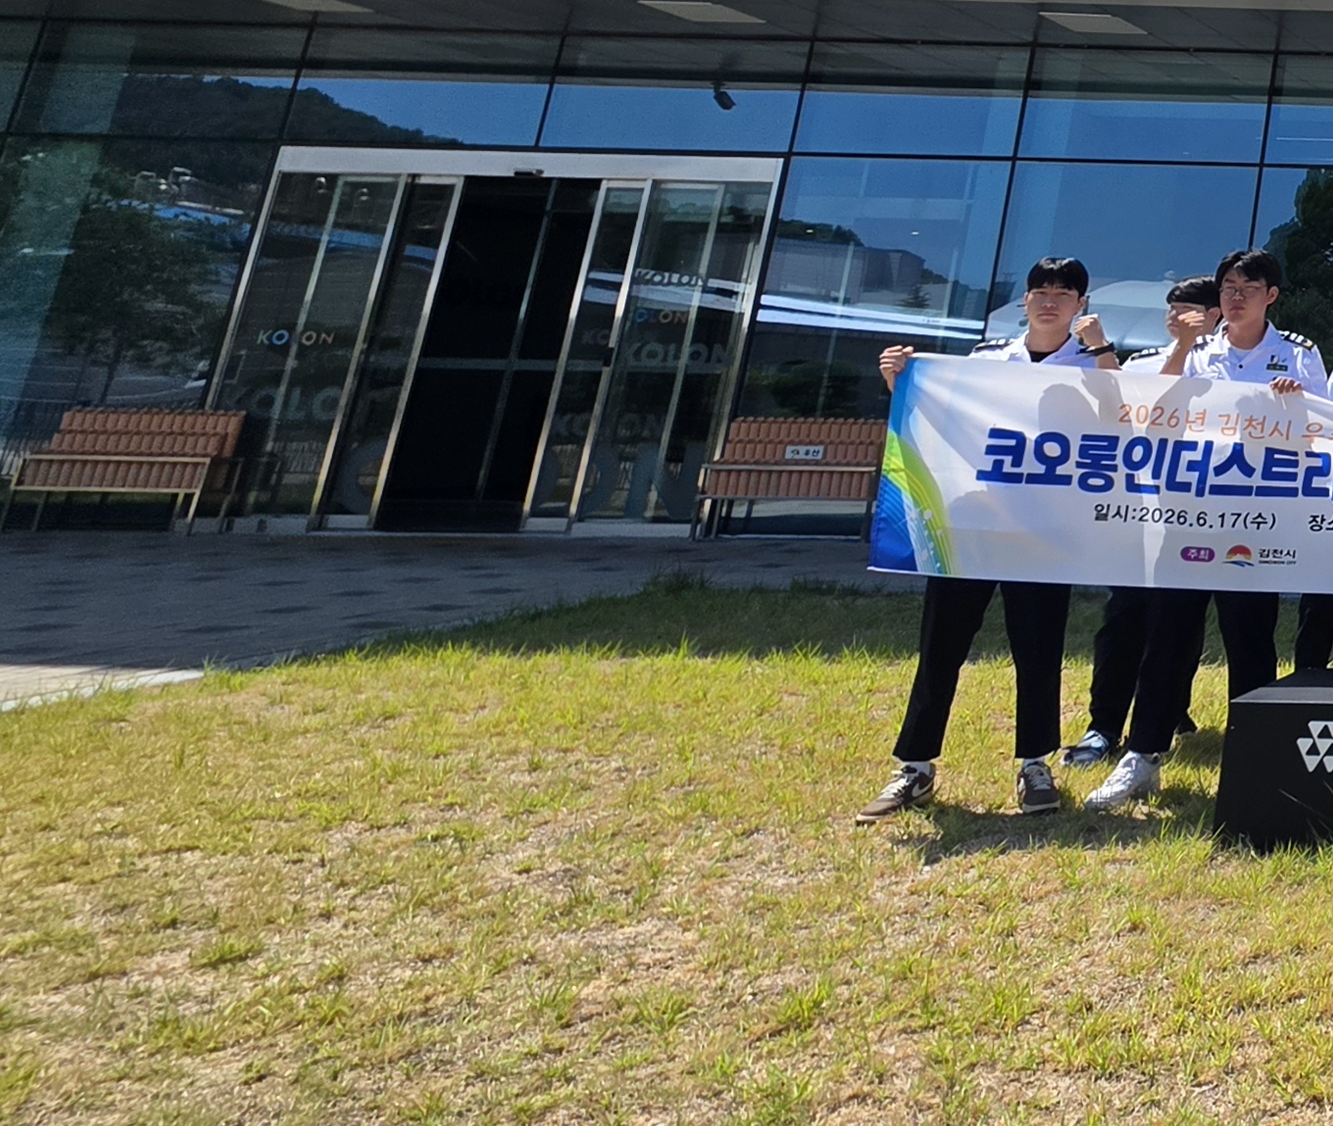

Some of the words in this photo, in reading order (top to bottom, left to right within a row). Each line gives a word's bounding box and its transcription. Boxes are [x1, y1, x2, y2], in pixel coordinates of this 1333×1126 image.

[257, 329, 335, 346] KOON
[1118, 403, 1207, 433] 2026년
[1218, 412, 1292, 441] 김천시
[1093, 502, 1278, 532] 일시:2026.6.17(수)
[1259, 548, 1296, 560] 김천시
